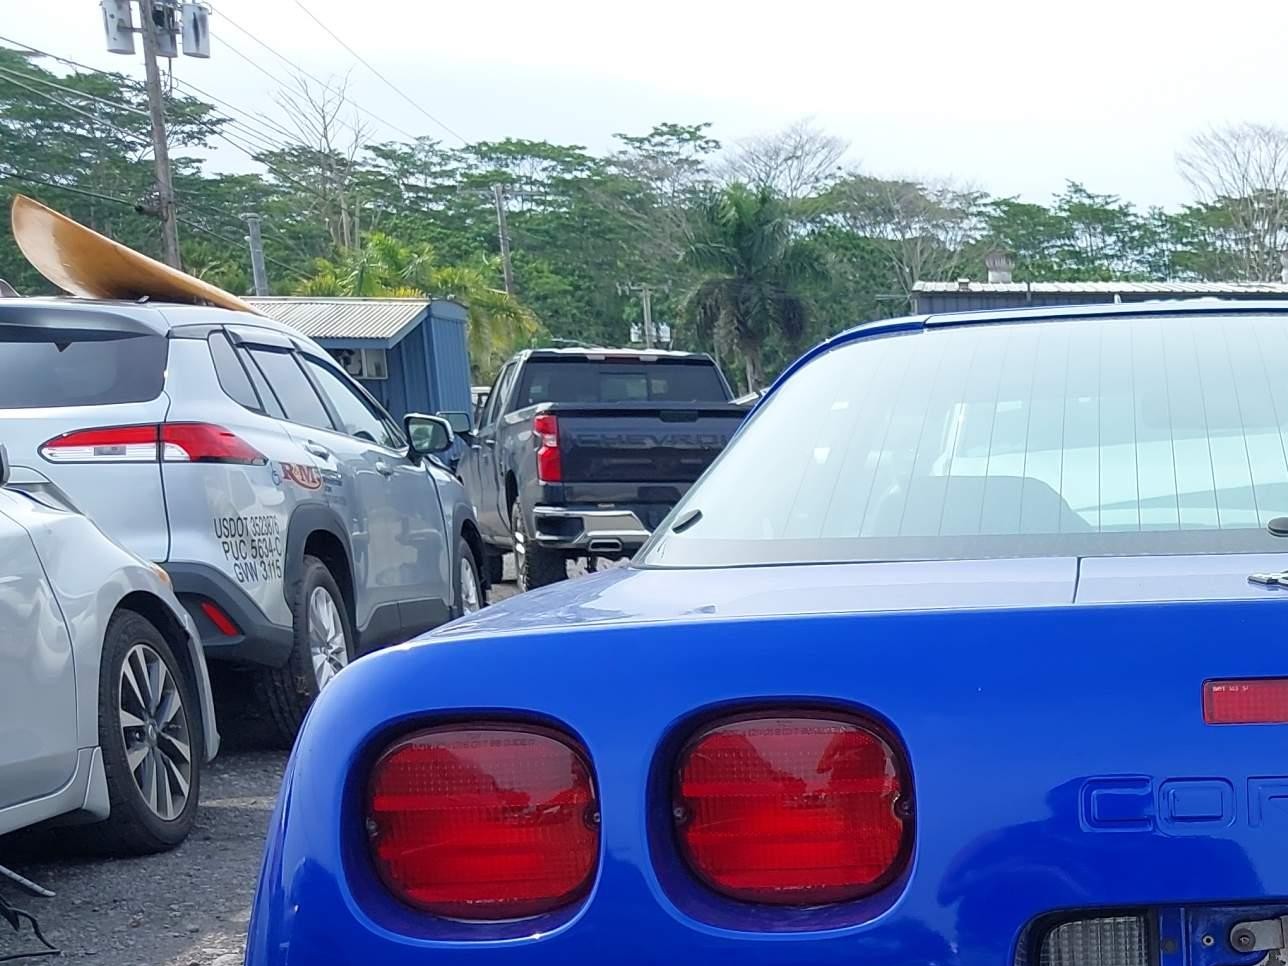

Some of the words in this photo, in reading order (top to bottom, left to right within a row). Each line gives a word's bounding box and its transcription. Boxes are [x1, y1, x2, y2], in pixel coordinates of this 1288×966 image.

[213, 516, 249, 539] USDOT
[222, 539, 248, 560] PUC
[251, 536, 282, 559] 5634-C
[234, 561, 259, 583] GVW
